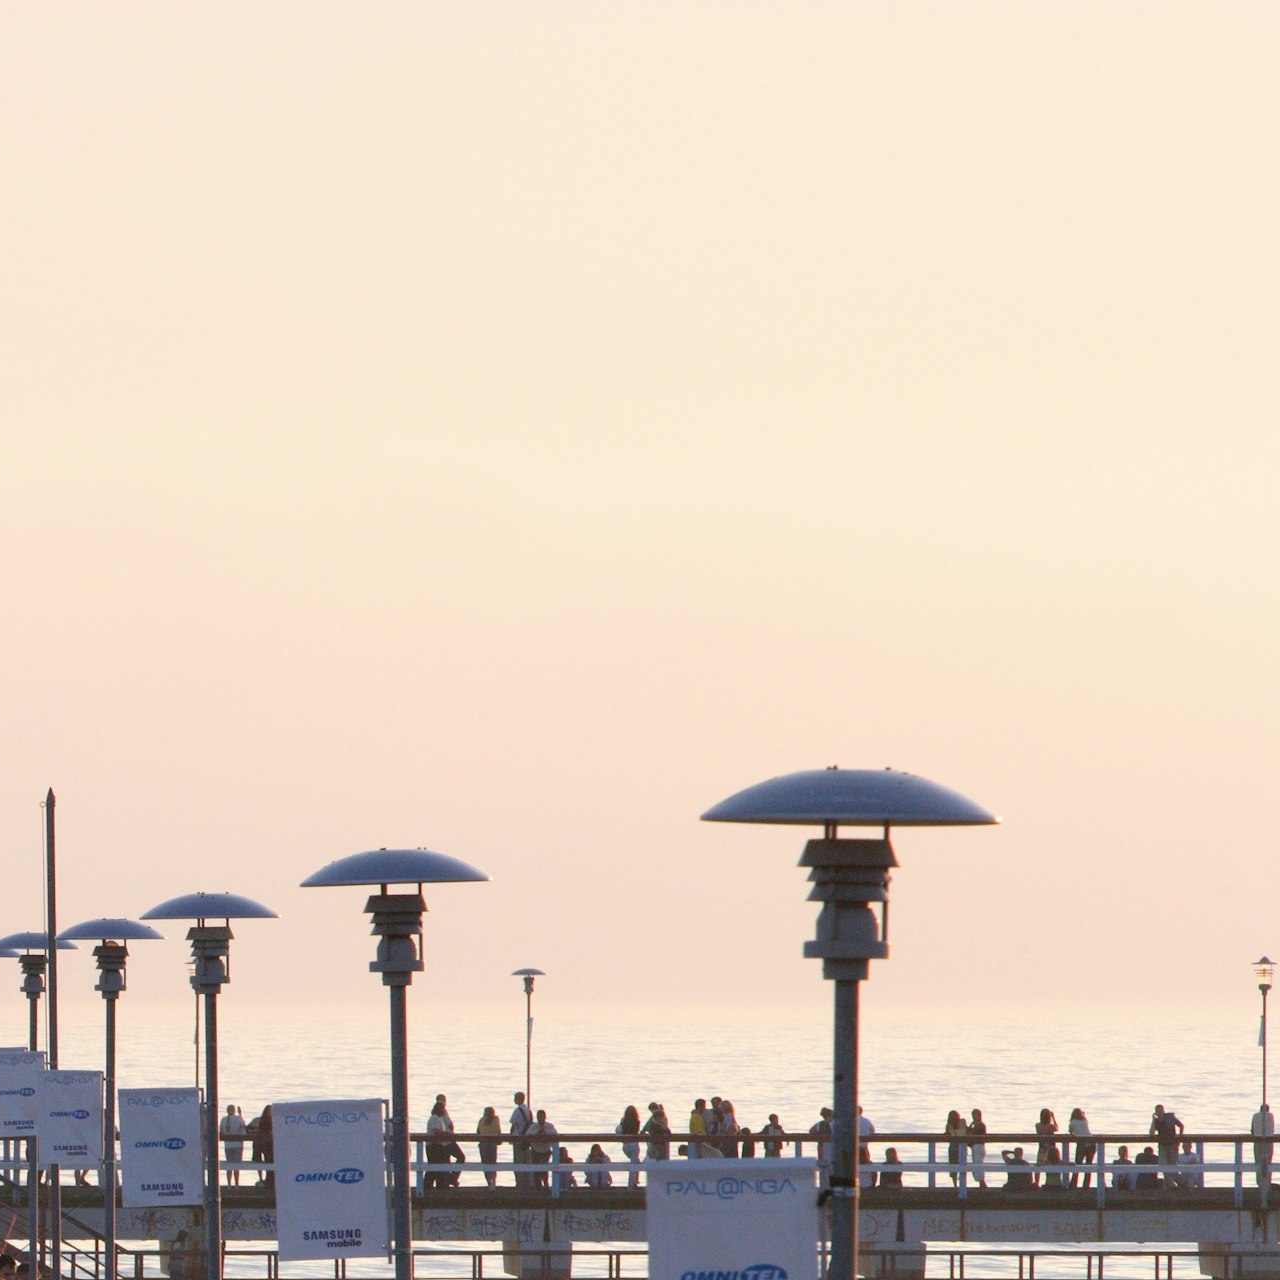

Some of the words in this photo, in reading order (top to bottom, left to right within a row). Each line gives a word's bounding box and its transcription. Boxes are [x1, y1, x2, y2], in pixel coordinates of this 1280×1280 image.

[49, 1109, 90, 1119] OMNITEL
[284, 1111, 369, 1126] PAL@NGA
[134, 1137, 186, 1150] OMNITEL
[295, 1167, 365, 1184] OMNITEL
[140, 1183, 184, 1191] SAMSUNG
[665, 1177, 797, 1199] PAL@NGA
[303, 1229, 362, 1240] SAMSUNG
[327, 1240, 362, 1248] mobile
